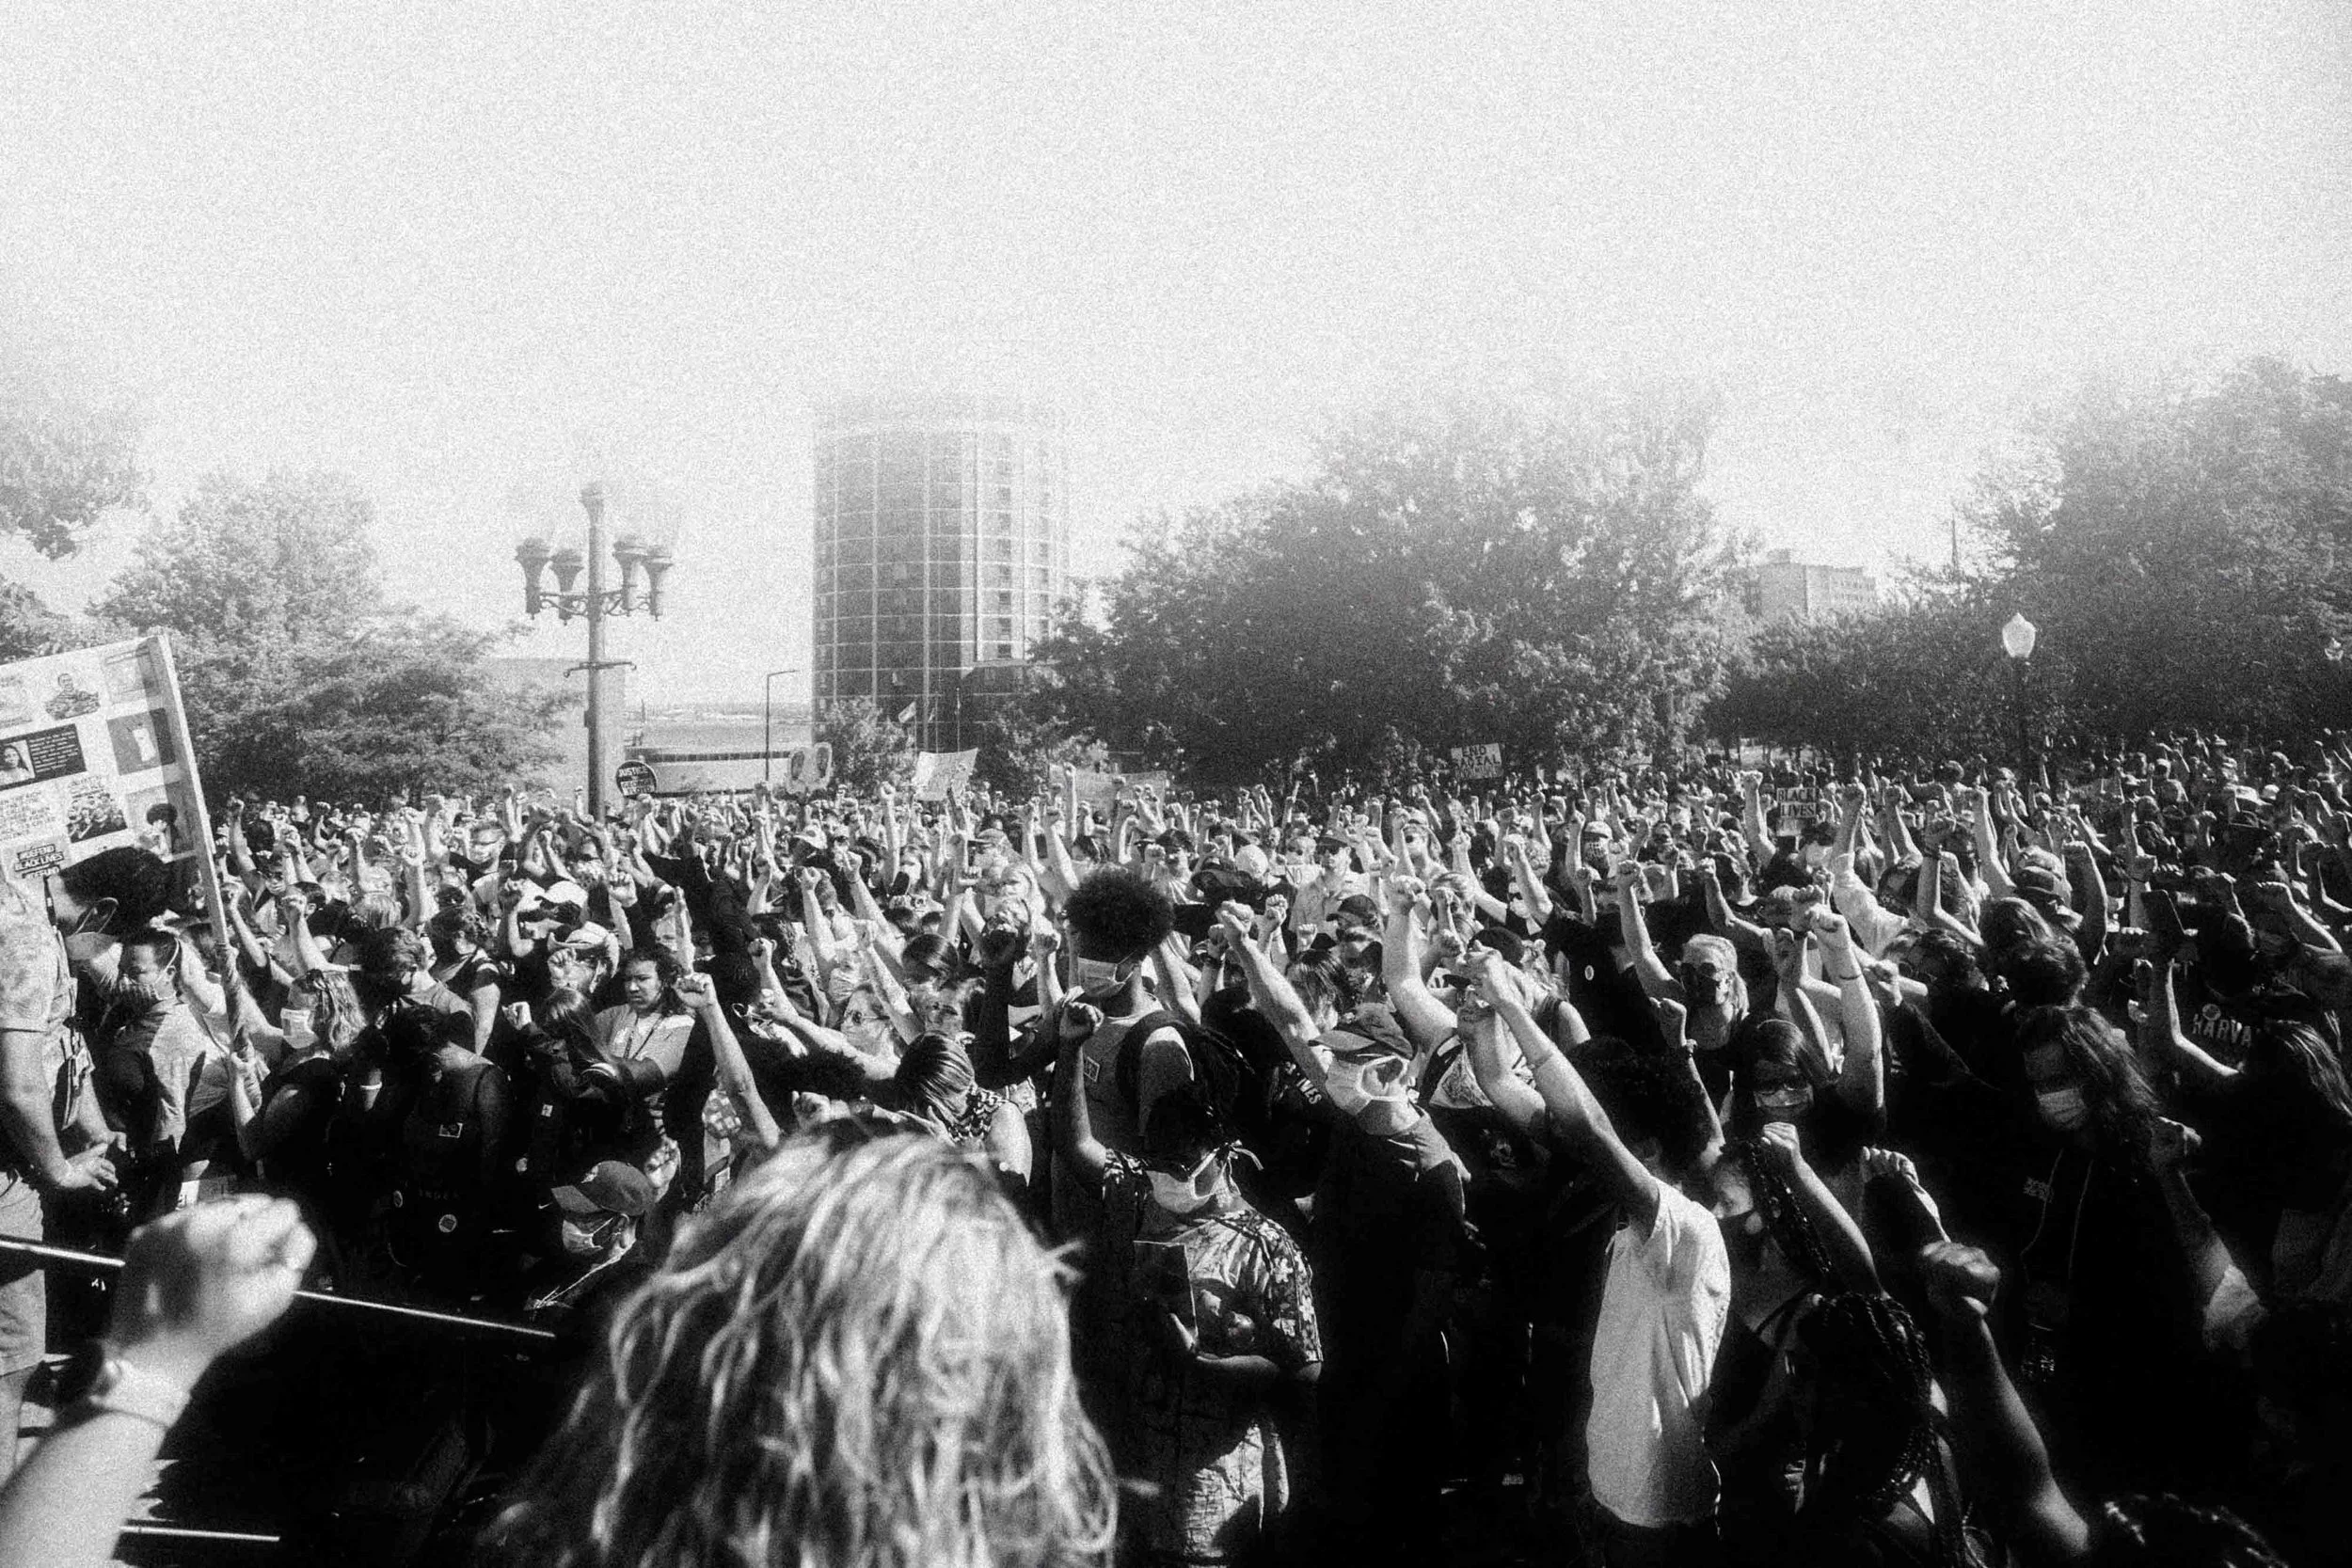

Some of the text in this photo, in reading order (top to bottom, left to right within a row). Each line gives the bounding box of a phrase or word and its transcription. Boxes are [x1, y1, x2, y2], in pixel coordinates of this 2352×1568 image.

[1461, 744, 1486, 755] END
[618, 767, 648, 778] JUSTICE
[622, 779, 652, 788] GEORGE
[1778, 789, 1813, 801] BLACK
[1782, 804, 1814, 816] LIVES
[14, 852, 63, 871] BLACK LIVES
[2193, 1014, 2251, 1048] HARVA
[1295, 1074, 1322, 1104] IVES
